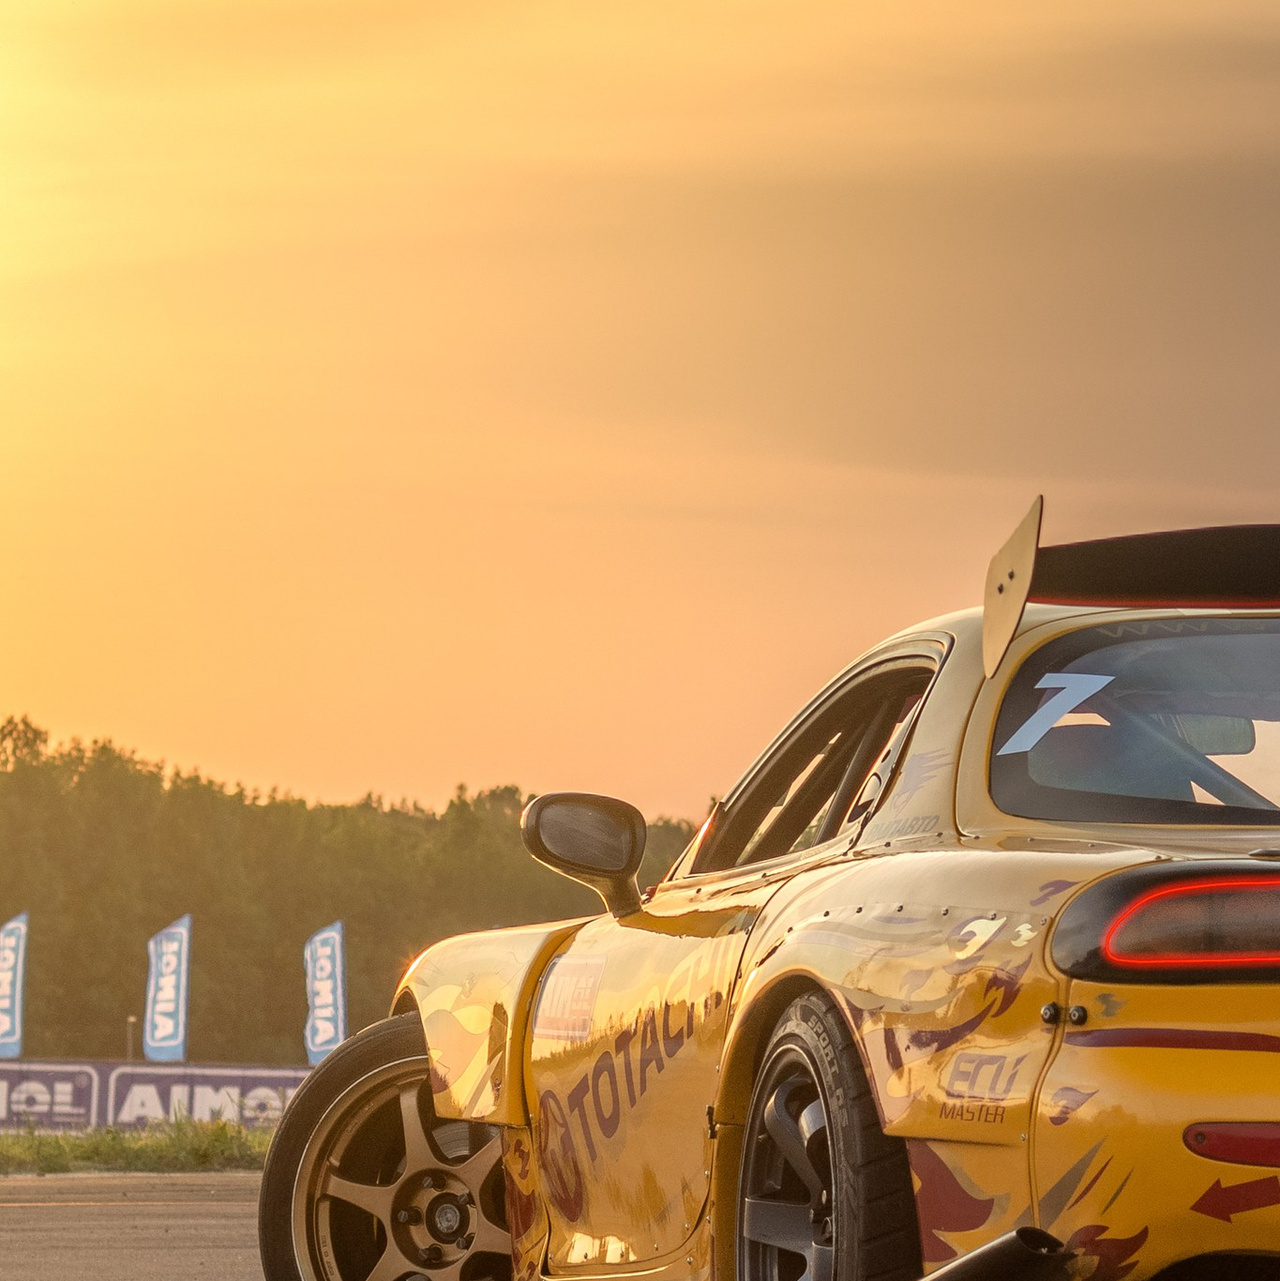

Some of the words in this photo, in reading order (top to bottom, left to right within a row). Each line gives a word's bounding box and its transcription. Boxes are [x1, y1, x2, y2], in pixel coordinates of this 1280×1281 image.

[945, 1050, 1032, 1101] ECU
[116, 1083, 299, 1124] AIMO
[939, 1102, 1006, 1124] MASTER
